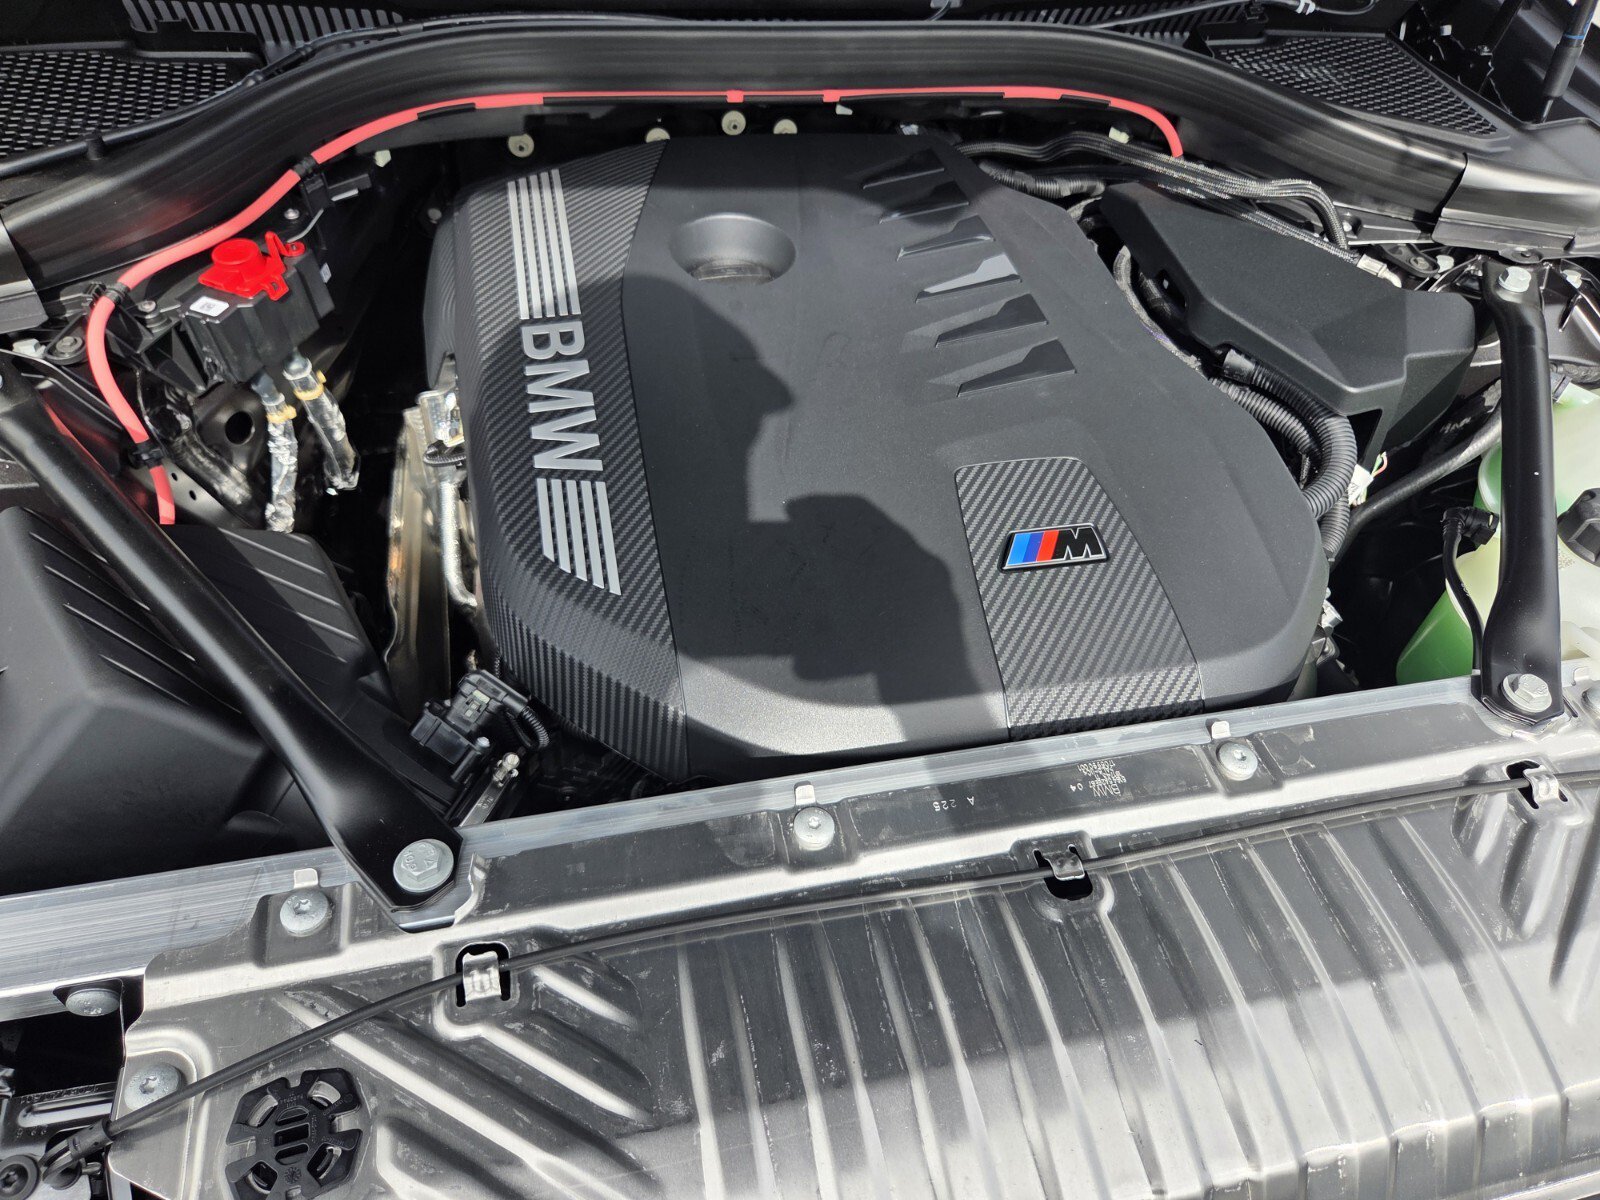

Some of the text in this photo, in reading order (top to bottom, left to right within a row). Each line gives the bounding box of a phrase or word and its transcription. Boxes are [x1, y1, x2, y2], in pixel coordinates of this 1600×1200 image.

[521, 320, 604, 472] BMW
[1069, 782, 1084, 792] 04
[1092, 782, 1121, 798] BMW
[966, 795, 975, 806] A
